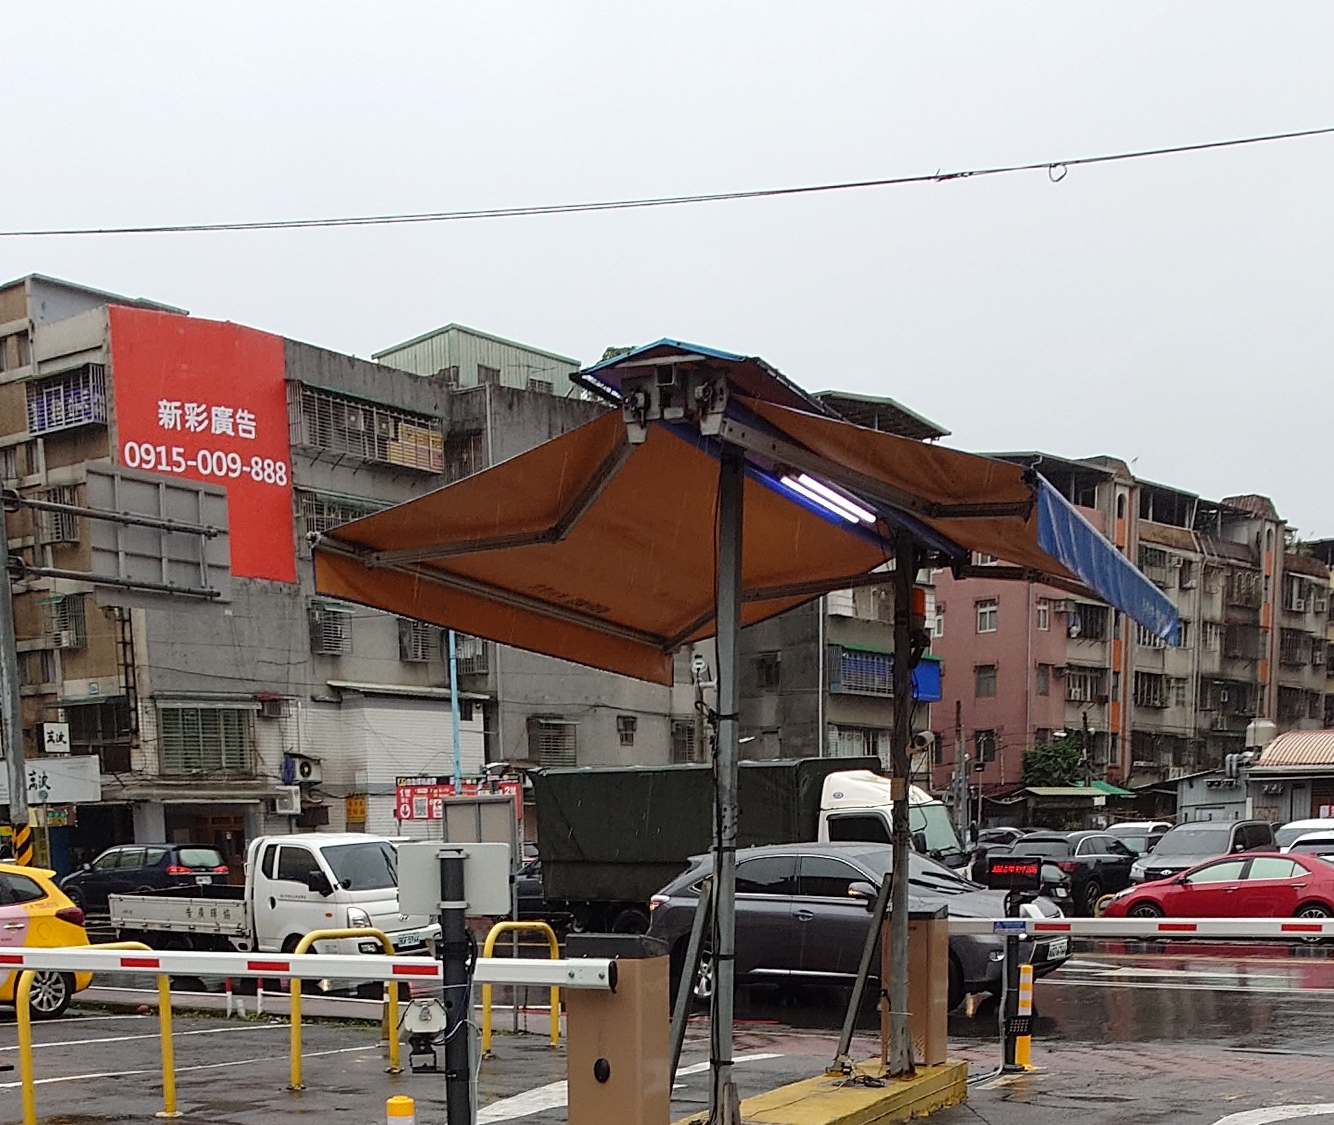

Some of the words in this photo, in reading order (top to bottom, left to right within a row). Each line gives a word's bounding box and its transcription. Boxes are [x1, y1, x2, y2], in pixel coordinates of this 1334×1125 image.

[158, 399, 256, 439] 新彩廣告
[124, 442, 287, 486] 0915-009-888
